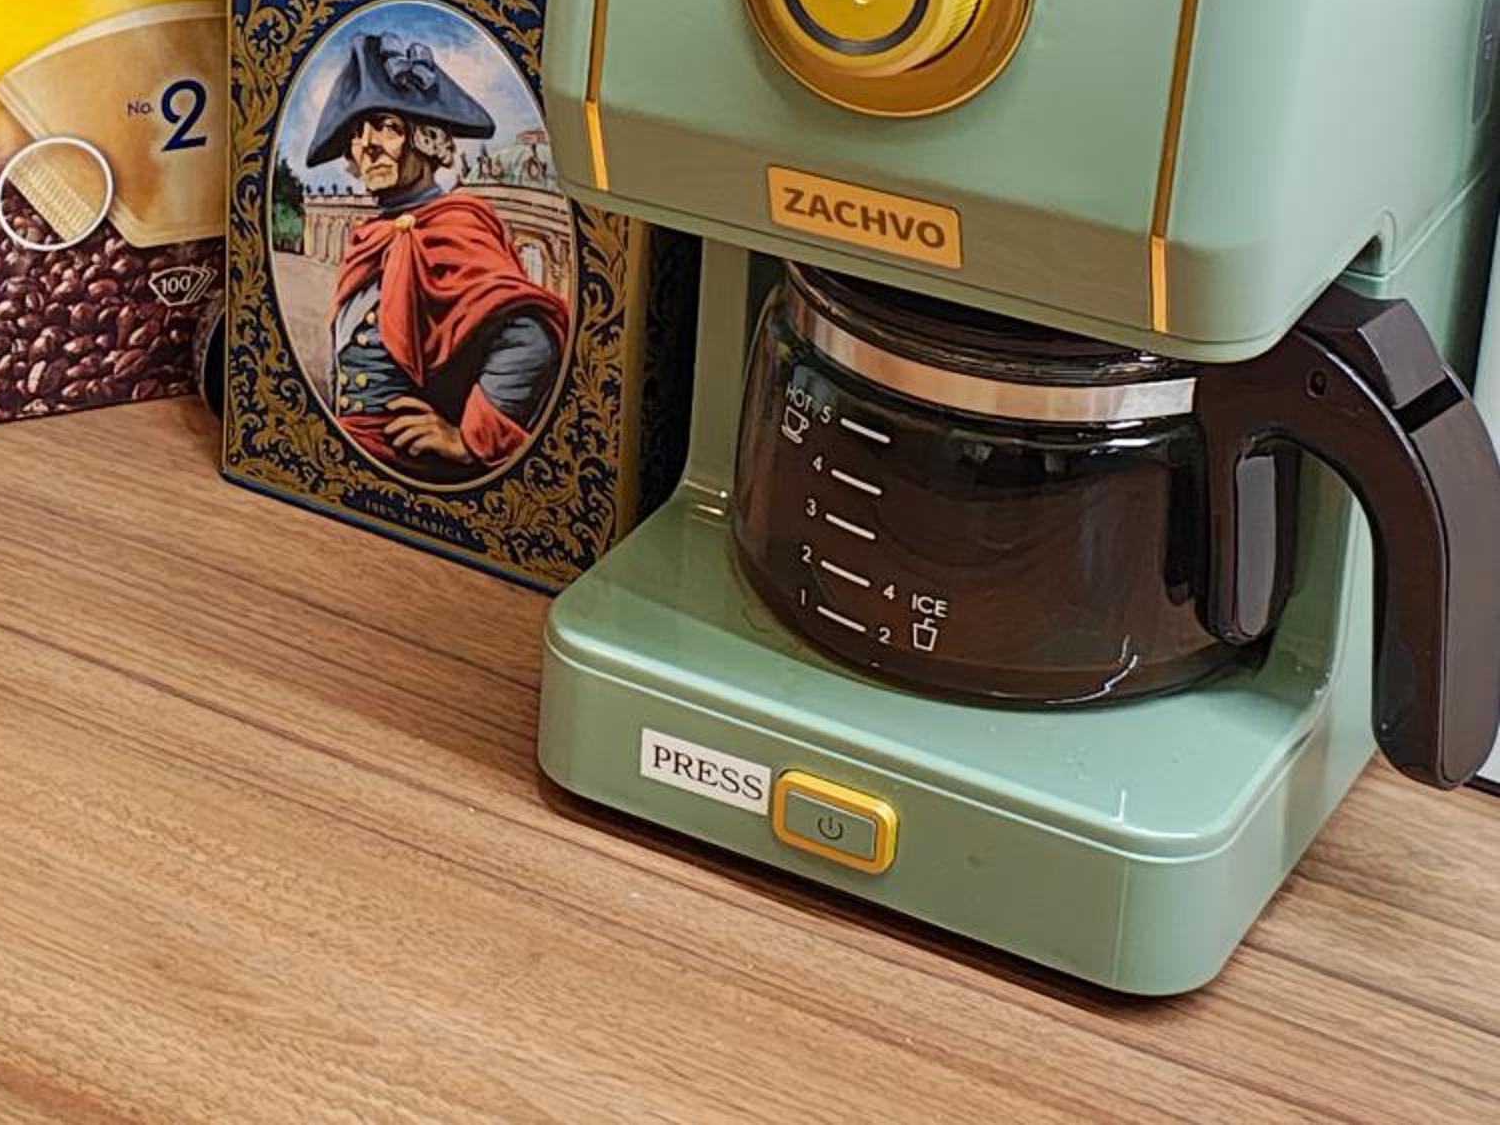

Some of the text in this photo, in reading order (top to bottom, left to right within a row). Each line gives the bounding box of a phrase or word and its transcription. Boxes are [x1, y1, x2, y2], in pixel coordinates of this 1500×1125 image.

[161, 79, 207, 152] 2
[784, 187, 945, 248] ZACHVO
[161, 277, 190, 293] 100
[785, 385, 831, 423] HOT 5
[812, 456, 822, 472] 4
[805, 499, 816, 516] 3
[801, 546, 812, 563] 2
[884, 584, 948, 618] 4 ICE
[879, 626, 892, 644] 2
[652, 745, 763, 800] PRESS
